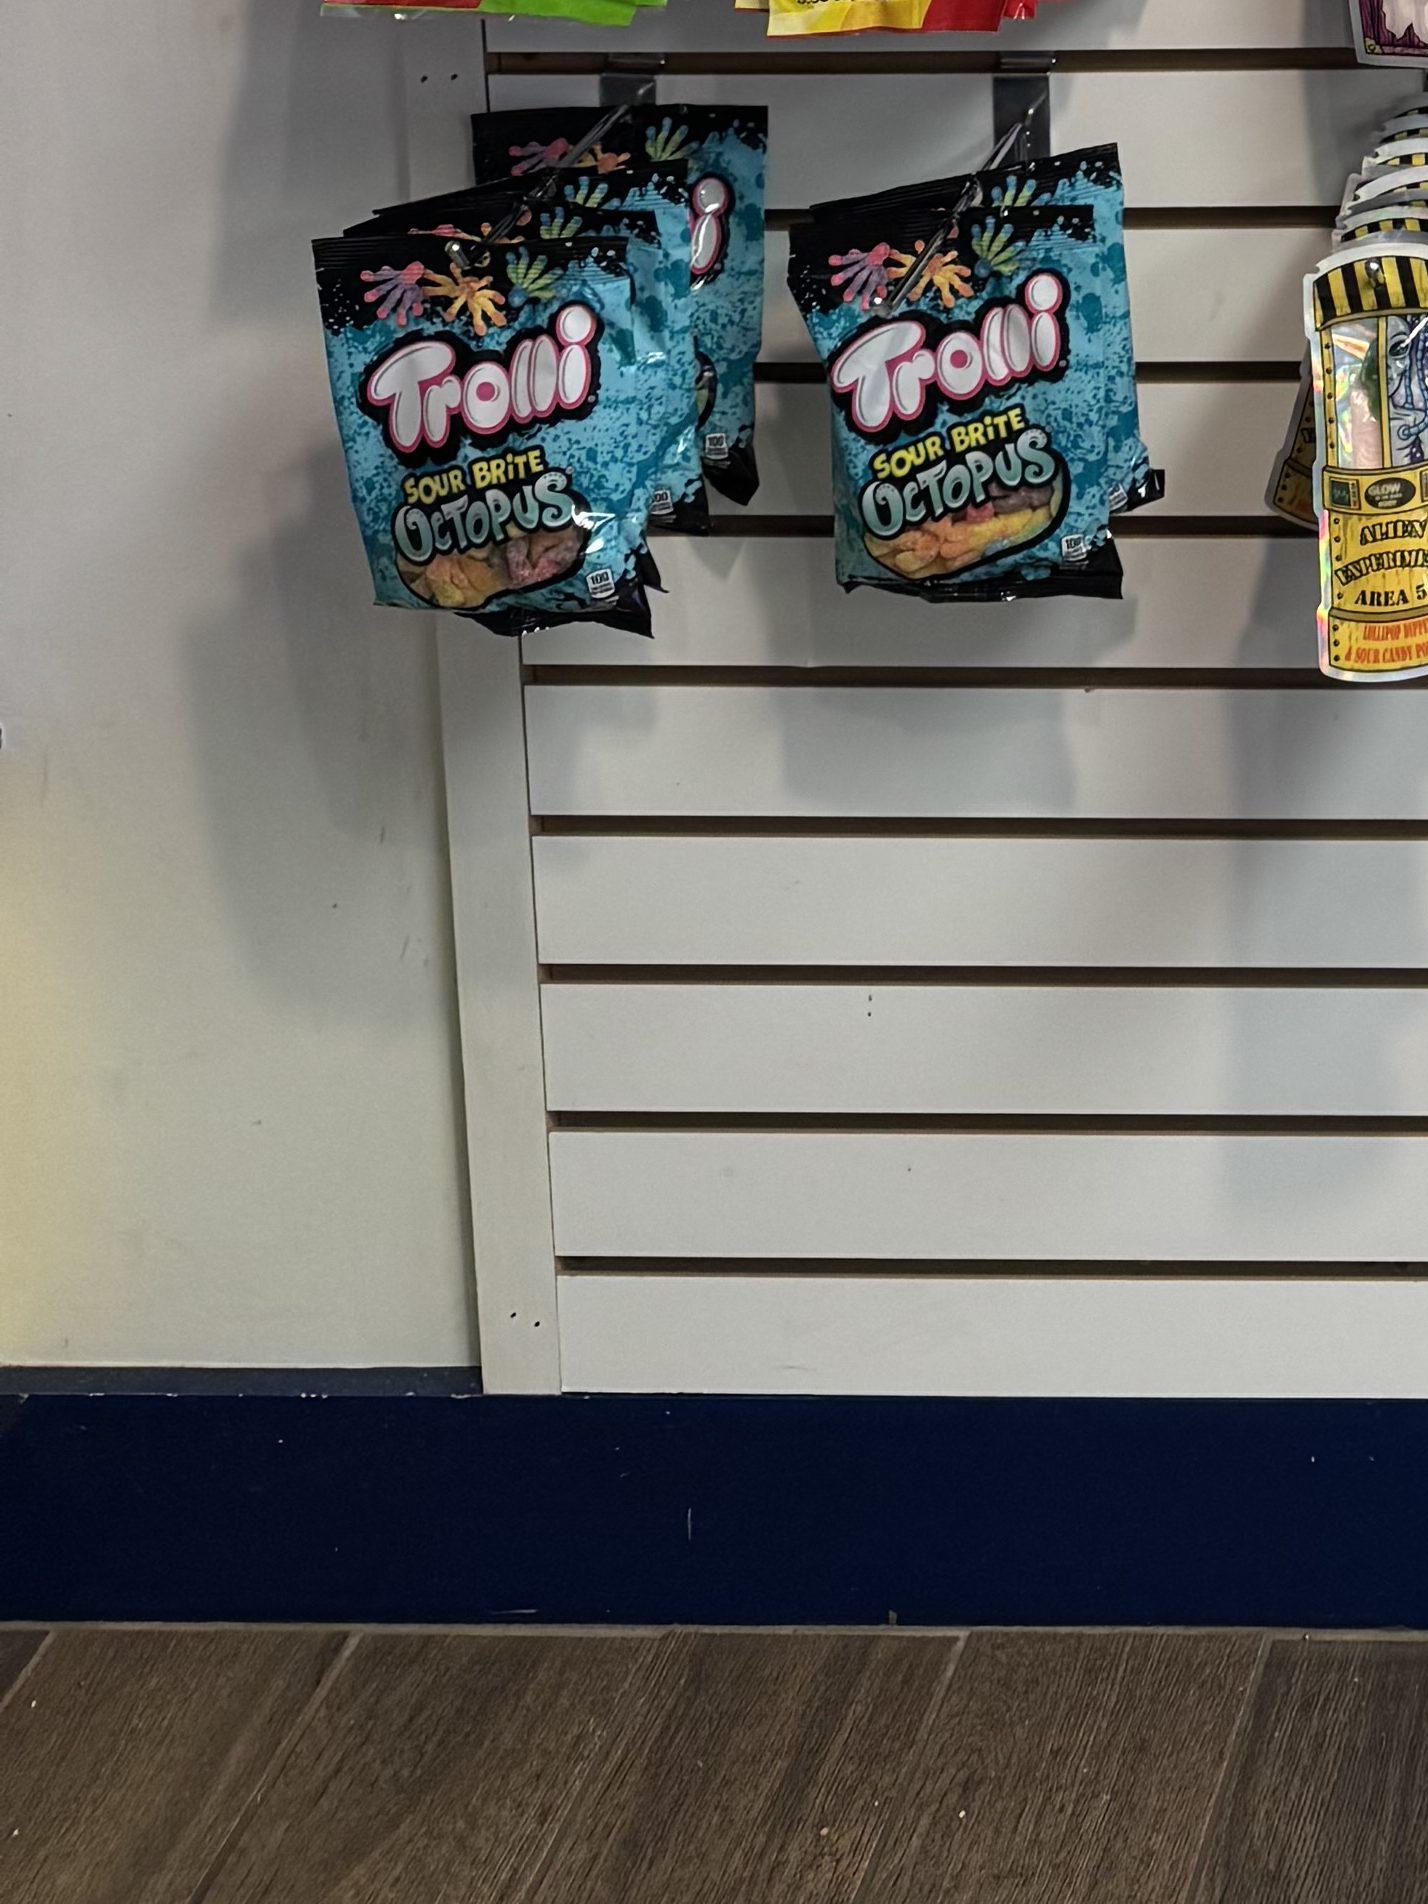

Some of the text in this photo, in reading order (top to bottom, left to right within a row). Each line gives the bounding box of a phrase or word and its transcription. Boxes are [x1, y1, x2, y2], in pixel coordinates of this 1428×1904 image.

[367, 302, 598, 454] Trolli
[830, 271, 1064, 433] Trolli
[1354, 588, 1409, 608] AREA
